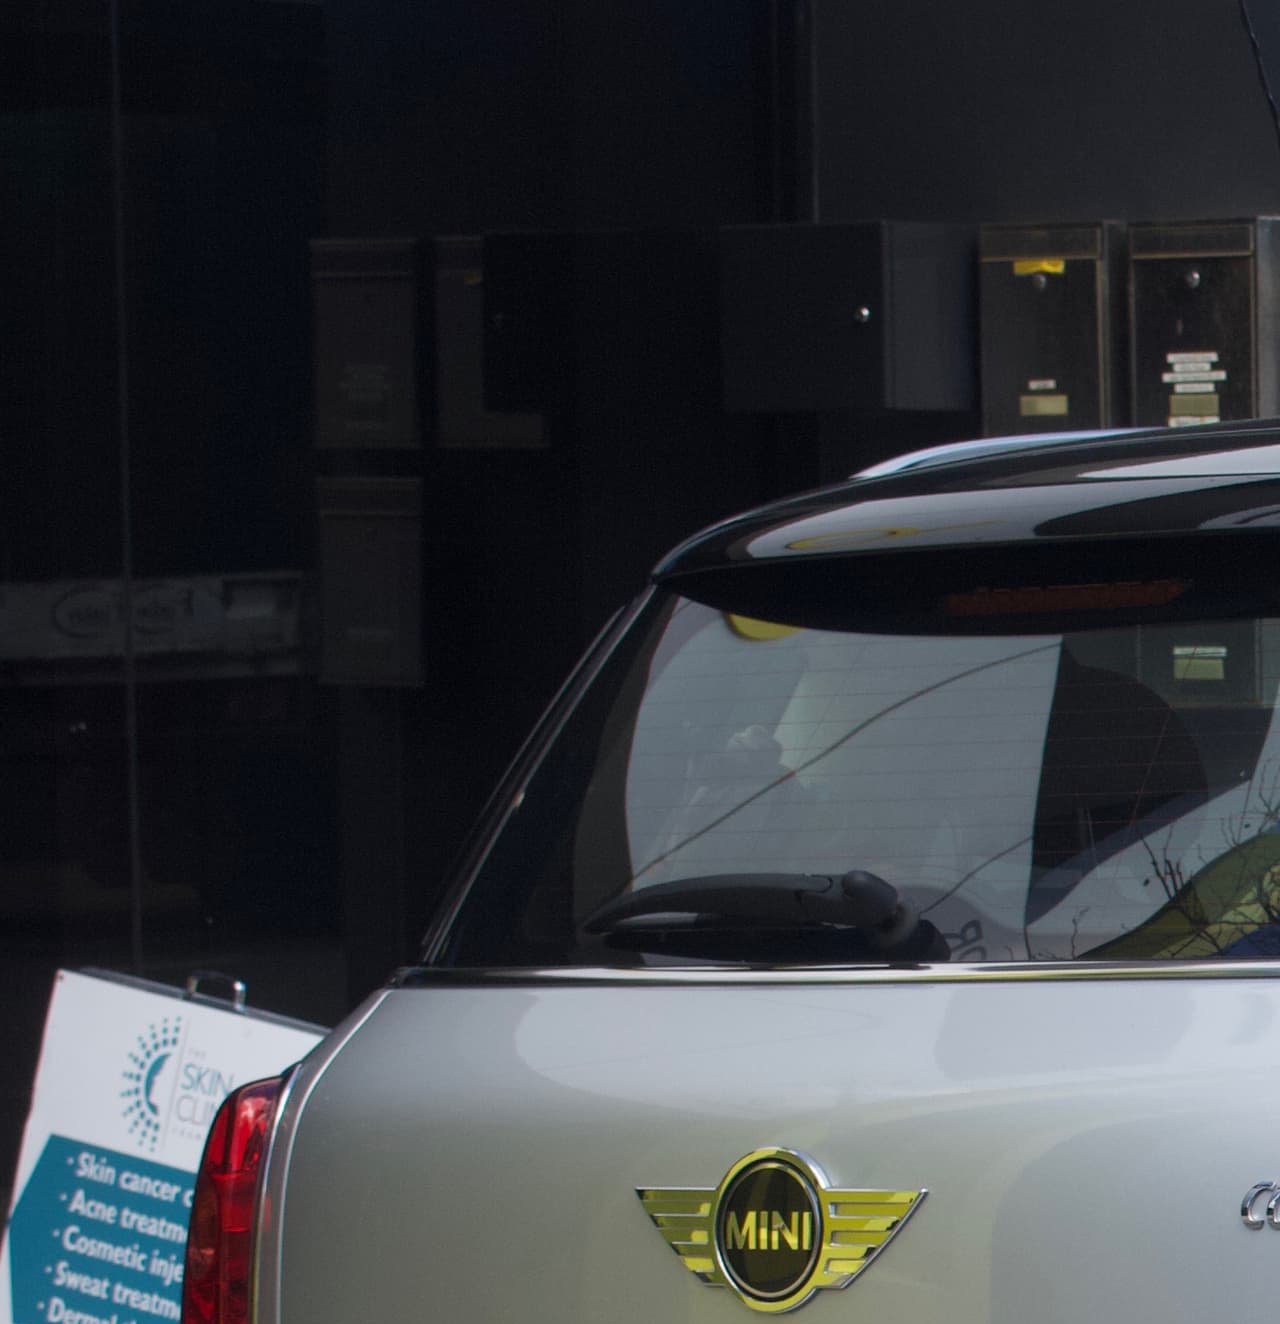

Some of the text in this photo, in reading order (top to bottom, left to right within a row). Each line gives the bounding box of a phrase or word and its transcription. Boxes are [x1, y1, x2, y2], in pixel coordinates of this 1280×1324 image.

[181, 1062, 234, 1097] SKIN
[75, 1151, 116, 1186] Skin
[119, 1170, 182, 1204] cancer
[68, 1189, 117, 1224] Acne
[62, 1225, 147, 1272] Cosmetic
[725, 1210, 813, 1252] MINI
[53, 1261, 110, 1300] Sweat
